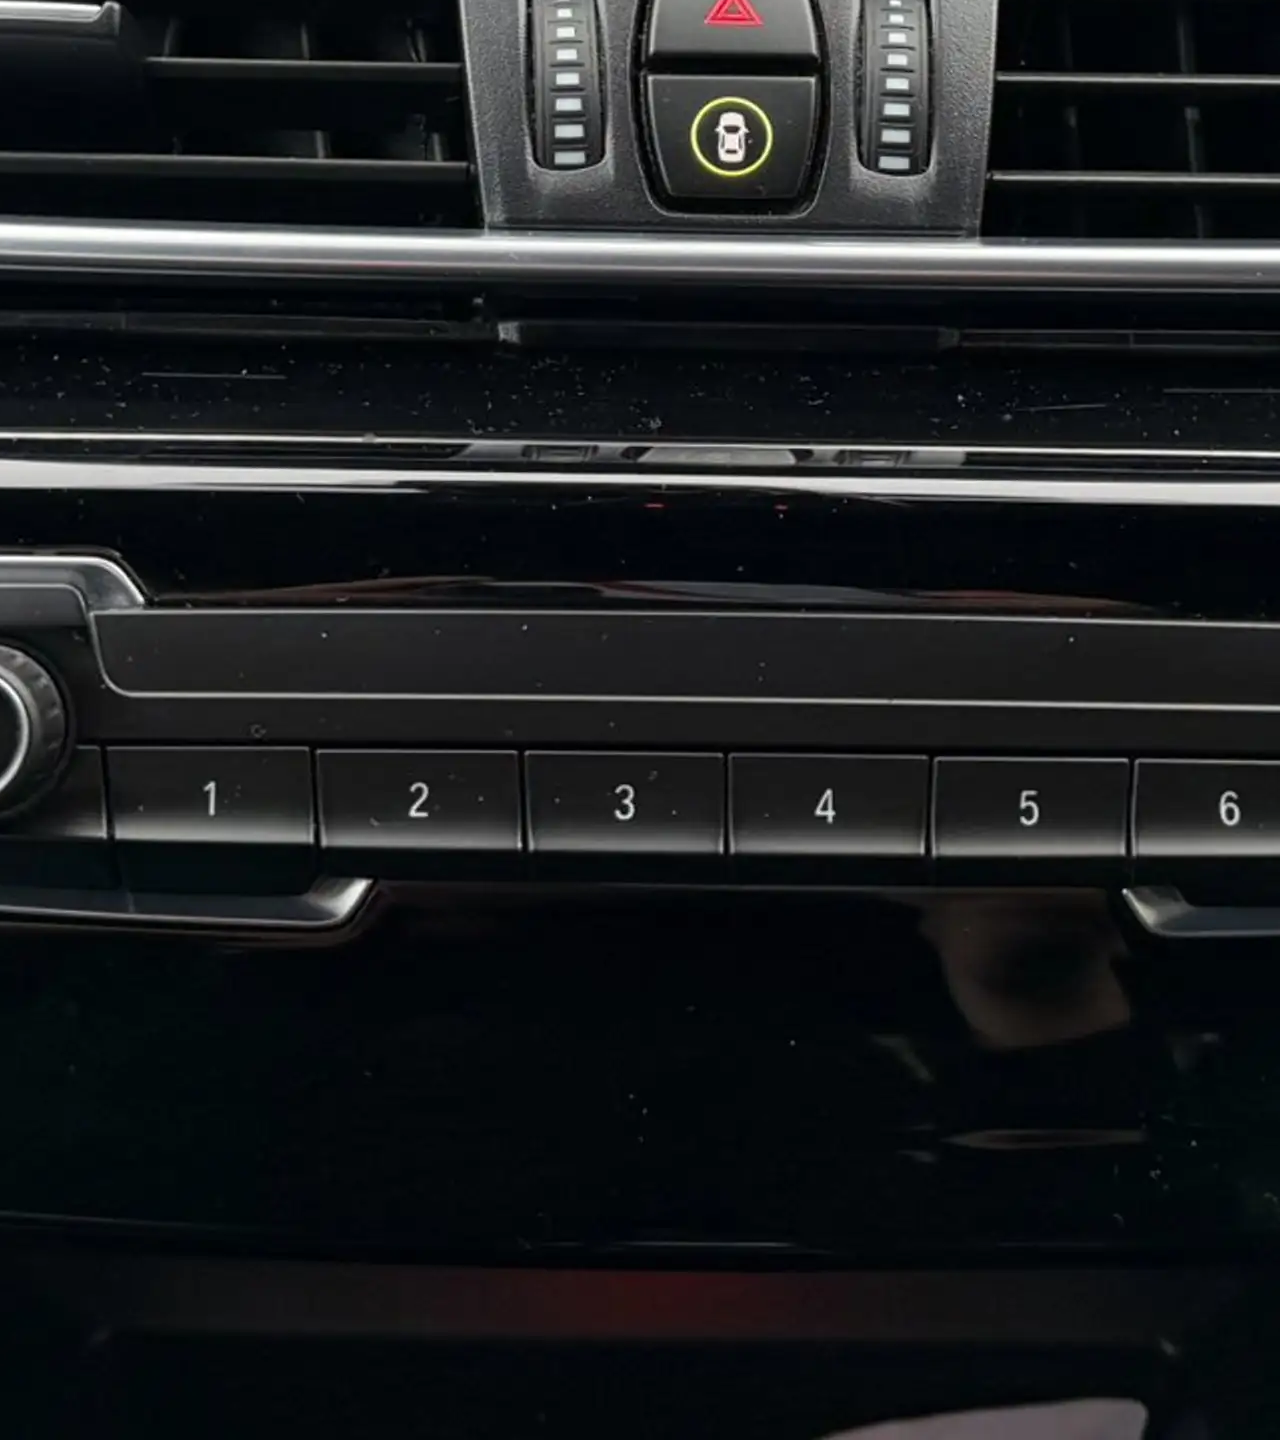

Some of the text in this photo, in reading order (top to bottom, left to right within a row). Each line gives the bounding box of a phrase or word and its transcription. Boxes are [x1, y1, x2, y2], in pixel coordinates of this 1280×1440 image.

[204, 781, 215, 816] 1
[408, 782, 428, 817] 2
[614, 784, 635, 820] 3
[815, 789, 836, 823] 4
[1020, 790, 1039, 826] 5
[1220, 791, 1240, 826] 6
